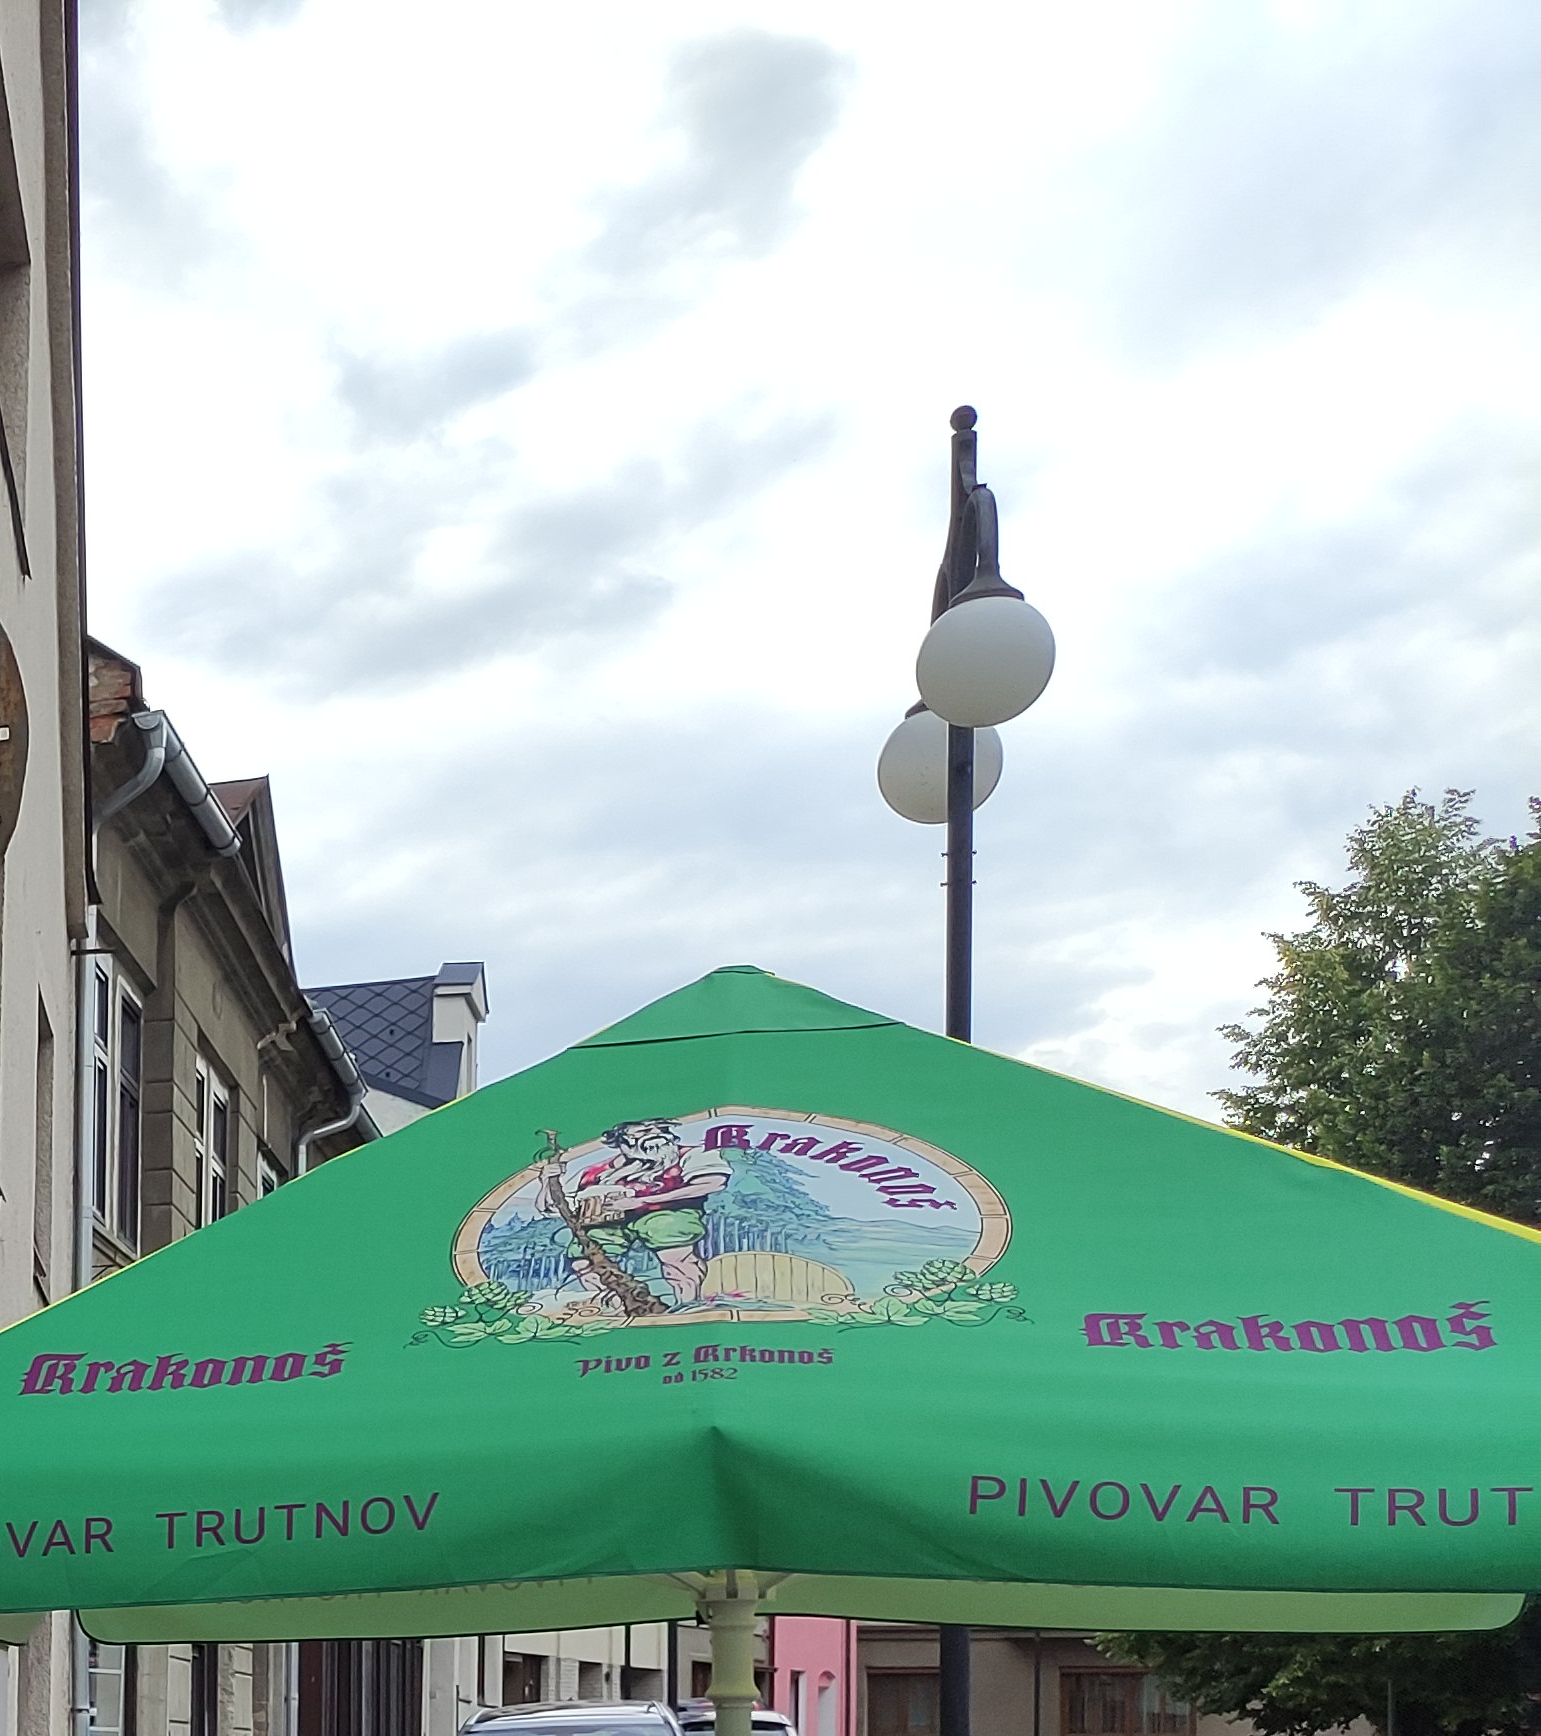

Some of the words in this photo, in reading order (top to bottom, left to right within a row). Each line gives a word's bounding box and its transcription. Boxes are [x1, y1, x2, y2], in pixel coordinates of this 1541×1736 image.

[1079, 1301, 1498, 1353] Krakonoš
[19, 1342, 353, 1396] Krakonoš
[574, 1354, 651, 1378] Pivo
[662, 1352, 681, 1367] z
[662, 1371, 684, 1384] od
[692, 1367, 738, 1382] 1582
[156, 1493, 440, 1551] TRUTNOV
[969, 1475, 1280, 1526] PIVOVAR
[1334, 1486, 1534, 1527] TRUT
